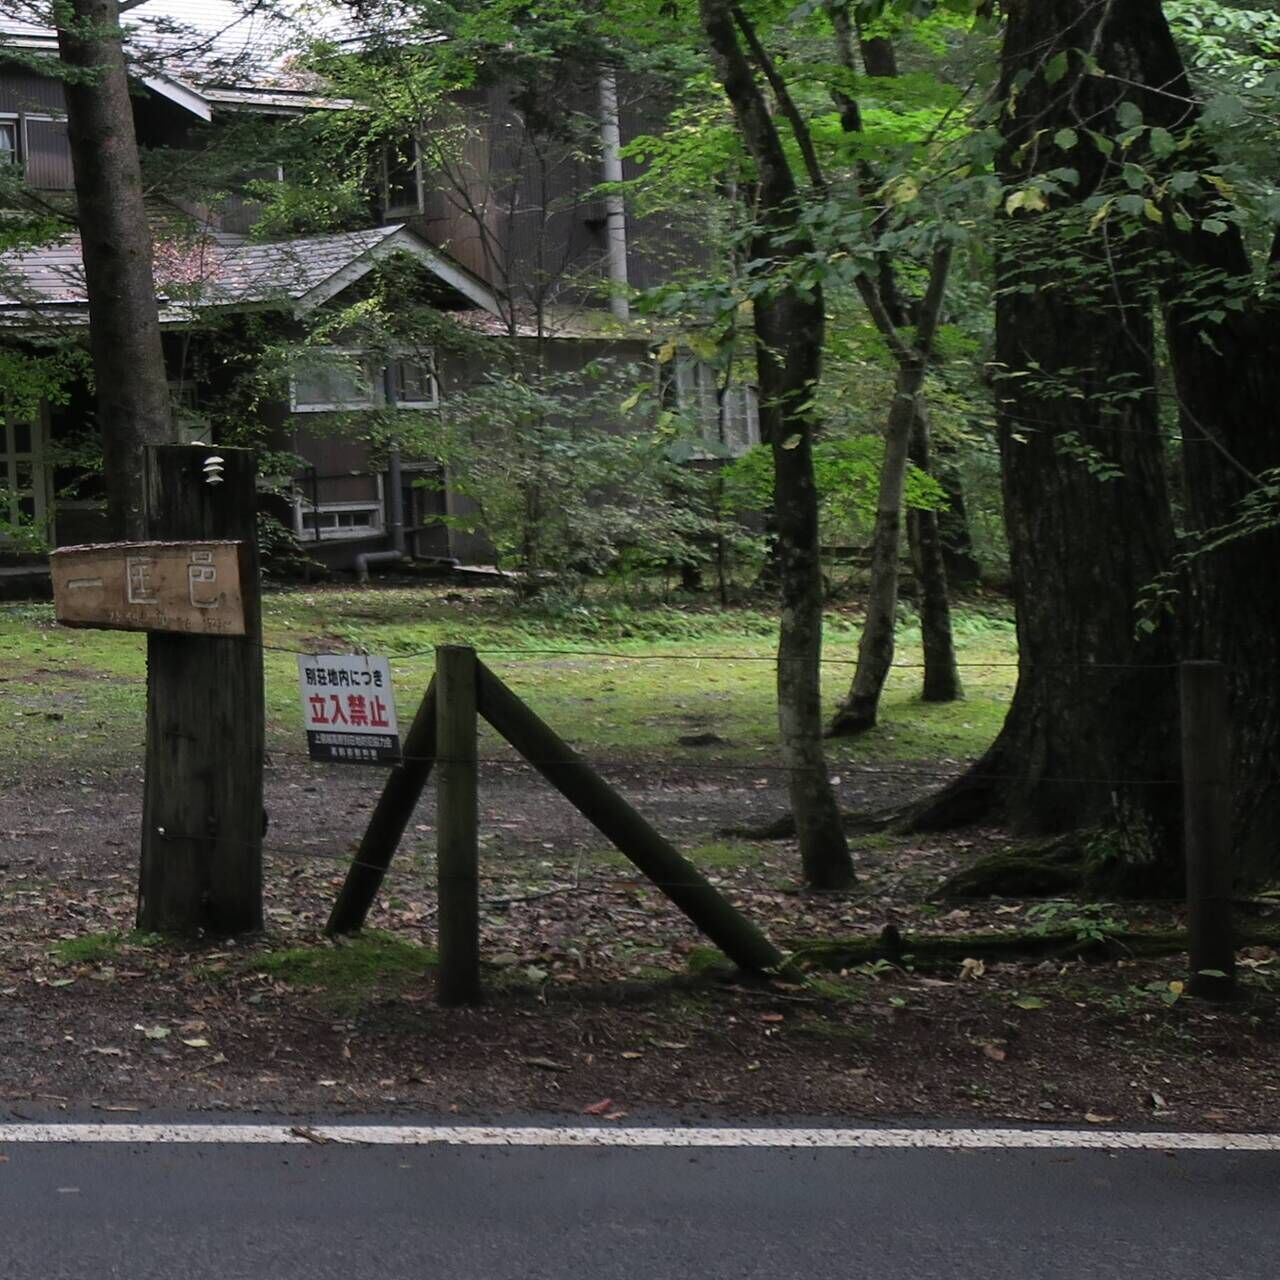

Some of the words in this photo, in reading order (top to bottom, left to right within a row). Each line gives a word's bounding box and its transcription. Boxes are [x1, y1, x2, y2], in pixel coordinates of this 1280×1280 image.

[305, 668, 383, 687] 別荘地内につき
[309, 693, 389, 727] 立入禁止
